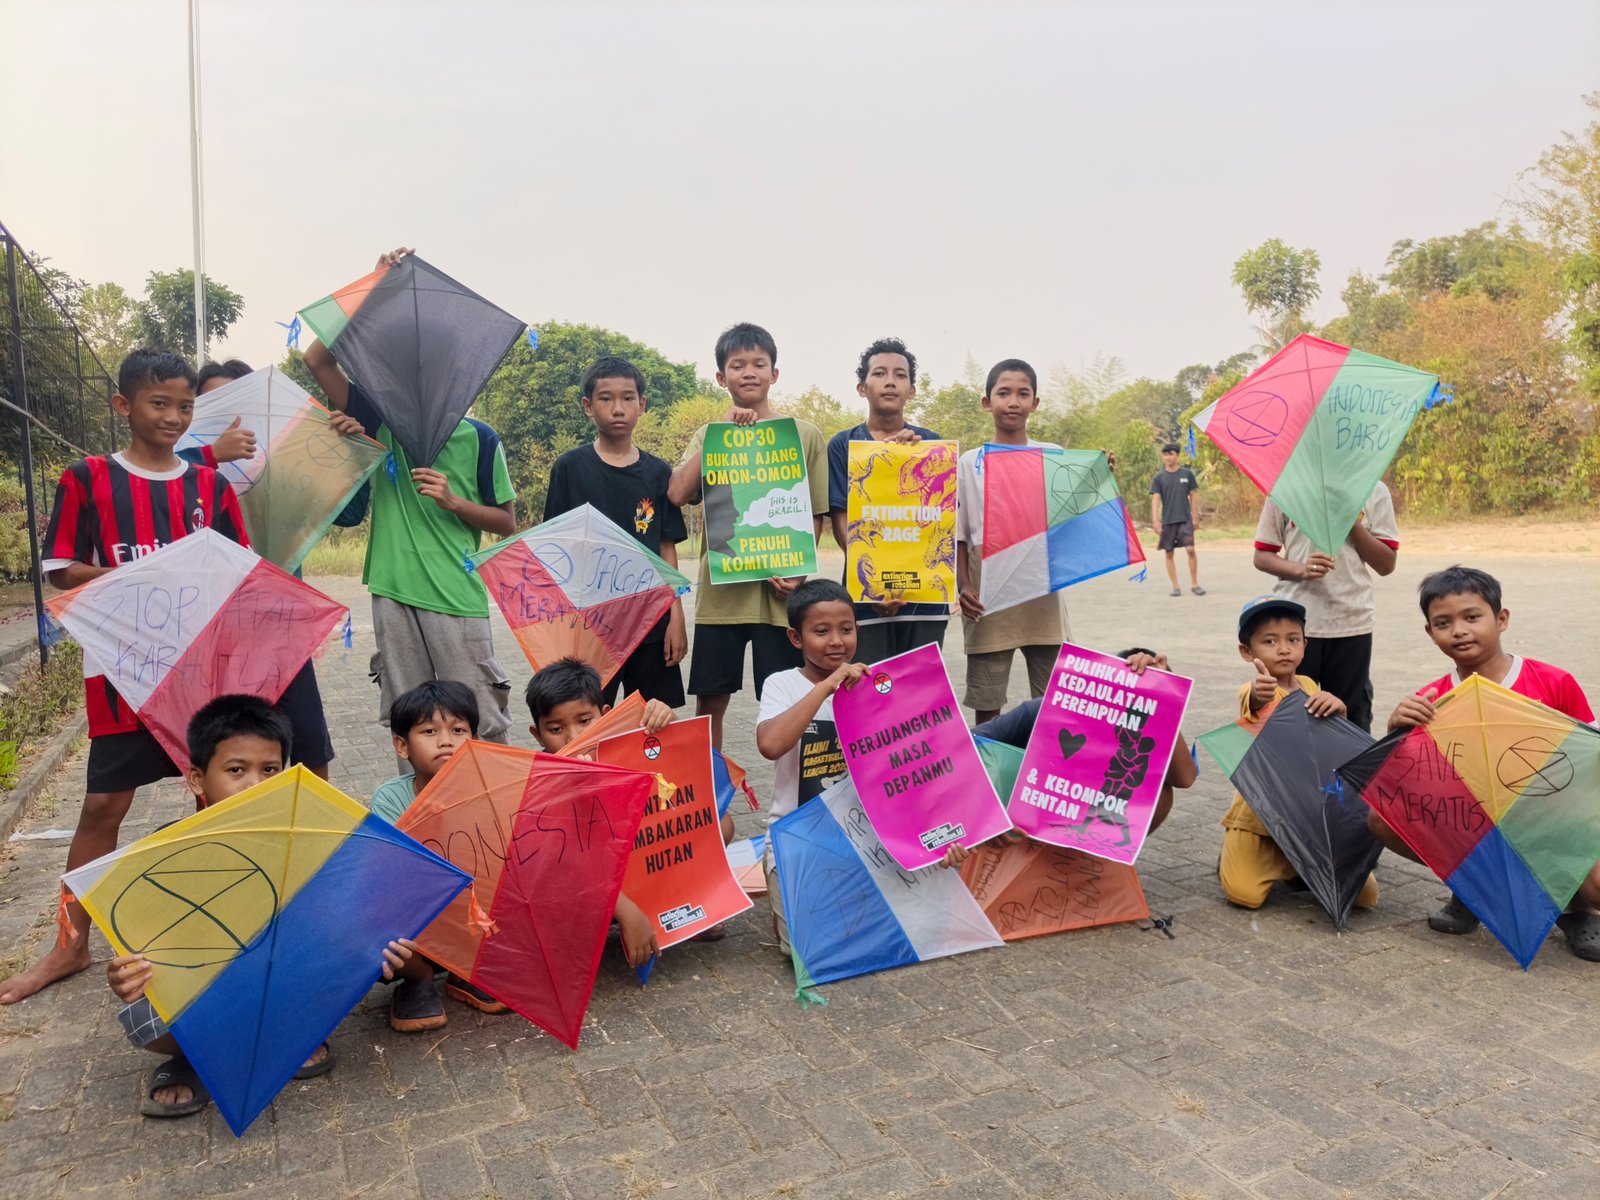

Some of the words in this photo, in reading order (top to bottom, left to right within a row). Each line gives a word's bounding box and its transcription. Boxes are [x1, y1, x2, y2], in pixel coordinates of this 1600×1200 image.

[723, 427, 776, 448] COP30
[1335, 417, 1392, 452] BARU
[706, 453, 749, 467] BUKAN
[755, 447, 799, 465] AJANG
[706, 463, 802, 486] OMON-OMON
[770, 496, 787, 507] THIS
[788, 496, 798, 505] IS
[862, 505, 942, 522] EXTINCTION
[739, 534, 791, 554] PENUHI
[882, 527, 921, 542] RAGE
[722, 551, 804, 573] KOMITMEN!
[882, 572, 914, 580] extinction
[891, 580, 920, 589] rebellion
[93, 578, 200, 637] STOP
[1063, 654, 1139, 689] PULIHKAN
[1057, 672, 1158, 716] KEDAULATAN
[1051, 690, 1142, 732] PEREMPUAN
[848, 704, 953, 759] PERJUANGKAN
[888, 740, 933, 770] MASA
[1395, 738, 1465, 783] SAVE
[883, 756, 954, 799] DEPANMU
[1020, 786, 1081, 820] RENTAN
[1026, 768, 1038, 785] &
[1044, 774, 1128, 815] KELOMPOK
[1377, 785, 1486, 833] MERATUS
[922, 825, 950, 843] extinction
[932, 827, 964, 848] rebellion.id
[645, 842, 694, 875] HUTAN
[661, 907, 688, 923] extinction
[671, 909, 705, 929] rebellion.id
